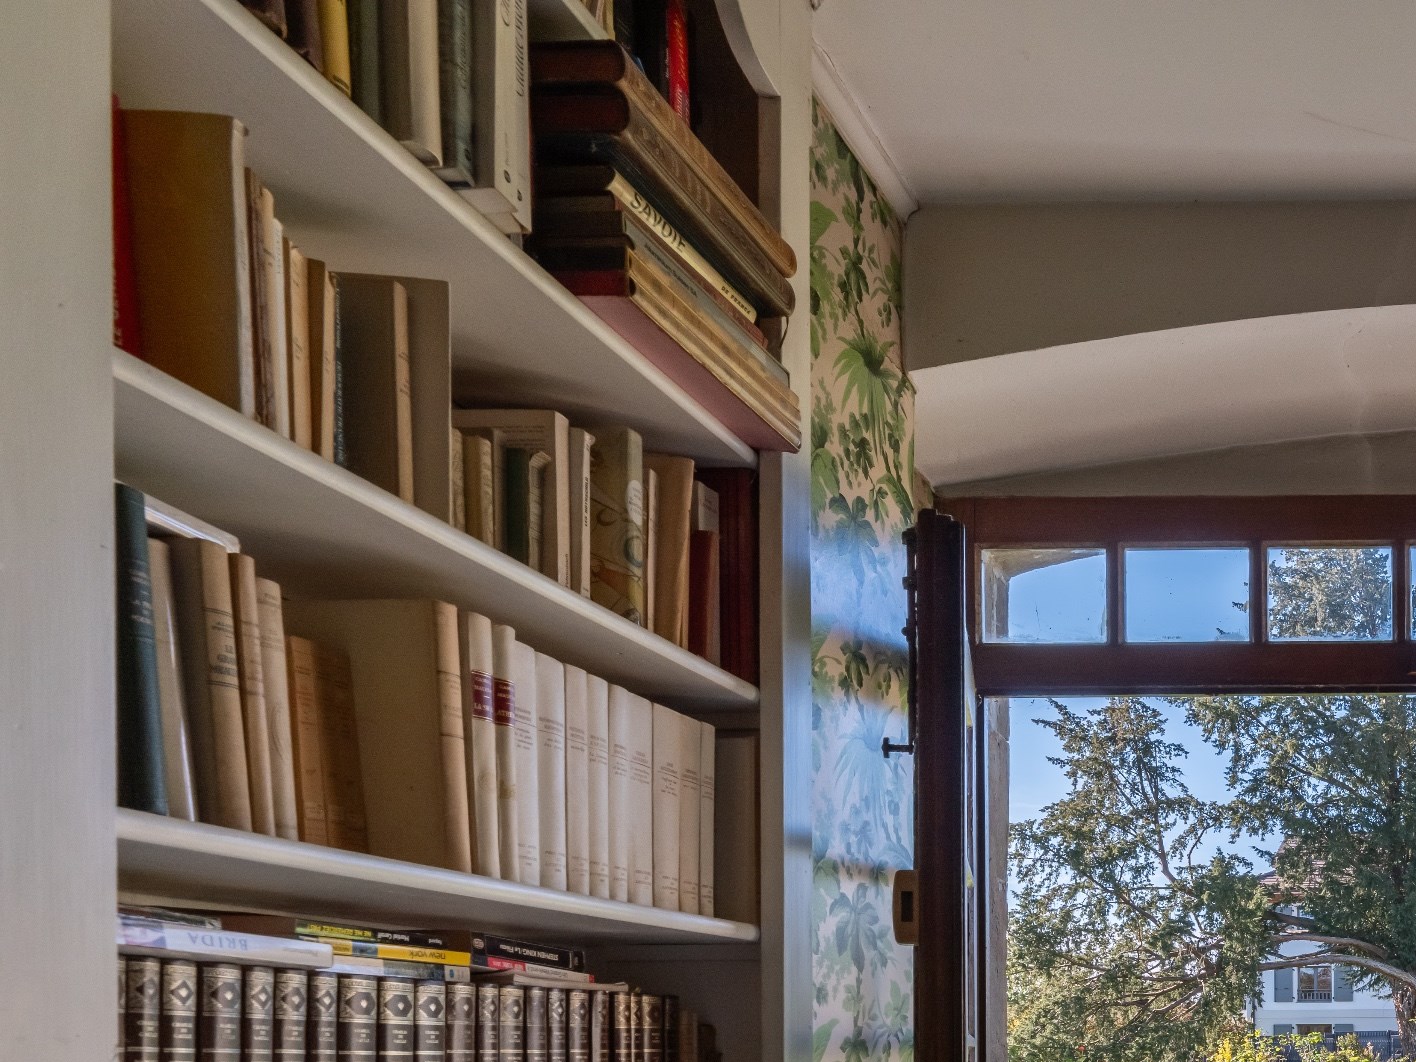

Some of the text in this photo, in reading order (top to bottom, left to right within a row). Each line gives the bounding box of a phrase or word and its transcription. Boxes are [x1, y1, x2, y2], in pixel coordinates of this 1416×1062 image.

[629, 191, 686, 253] SAVOIE
[187, 932, 250, 950] BRIDA
[408, 950, 446, 960] new york
[537, 950, 559, 961] STEPHEN
